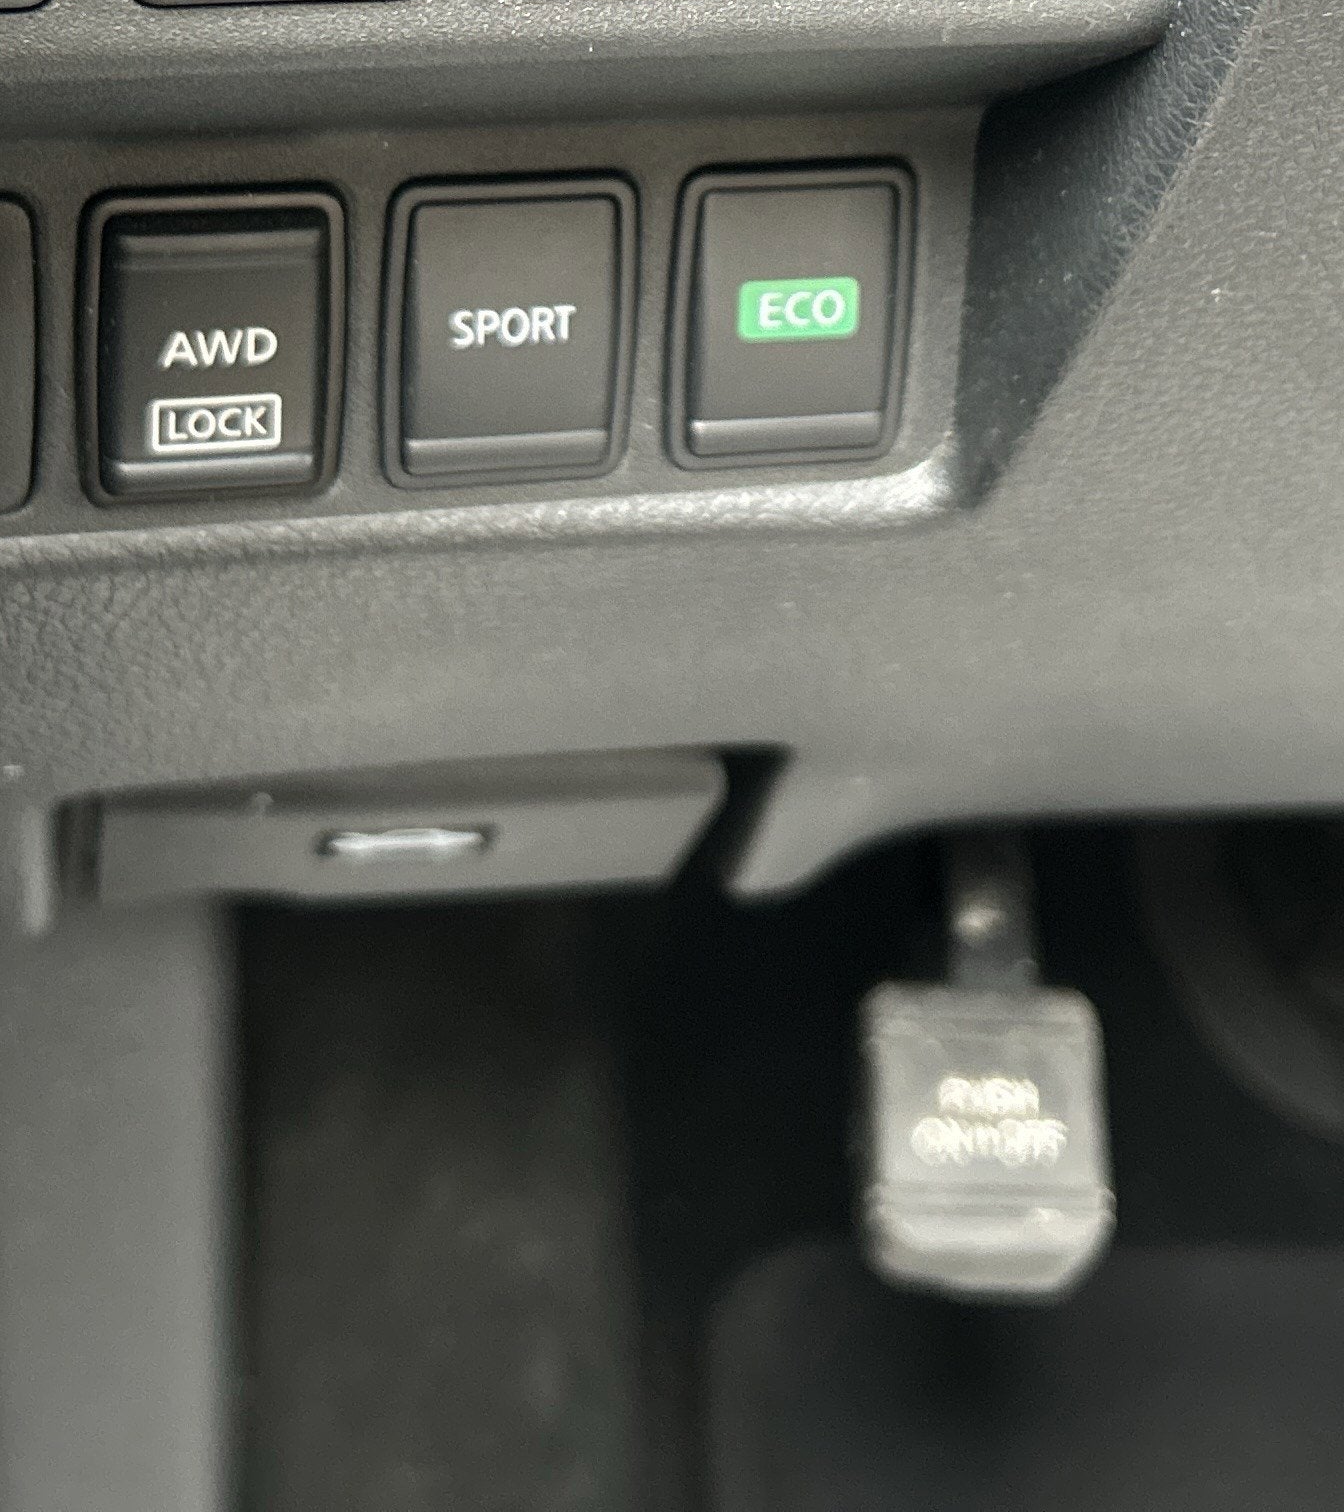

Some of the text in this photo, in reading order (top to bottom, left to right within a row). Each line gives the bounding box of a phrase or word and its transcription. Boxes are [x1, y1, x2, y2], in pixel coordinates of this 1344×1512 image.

[451, 303, 577, 349] SPORT
[760, 290, 845, 330] ECO
[161, 327, 278, 369] AWD
[166, 407, 268, 442] LOCK
